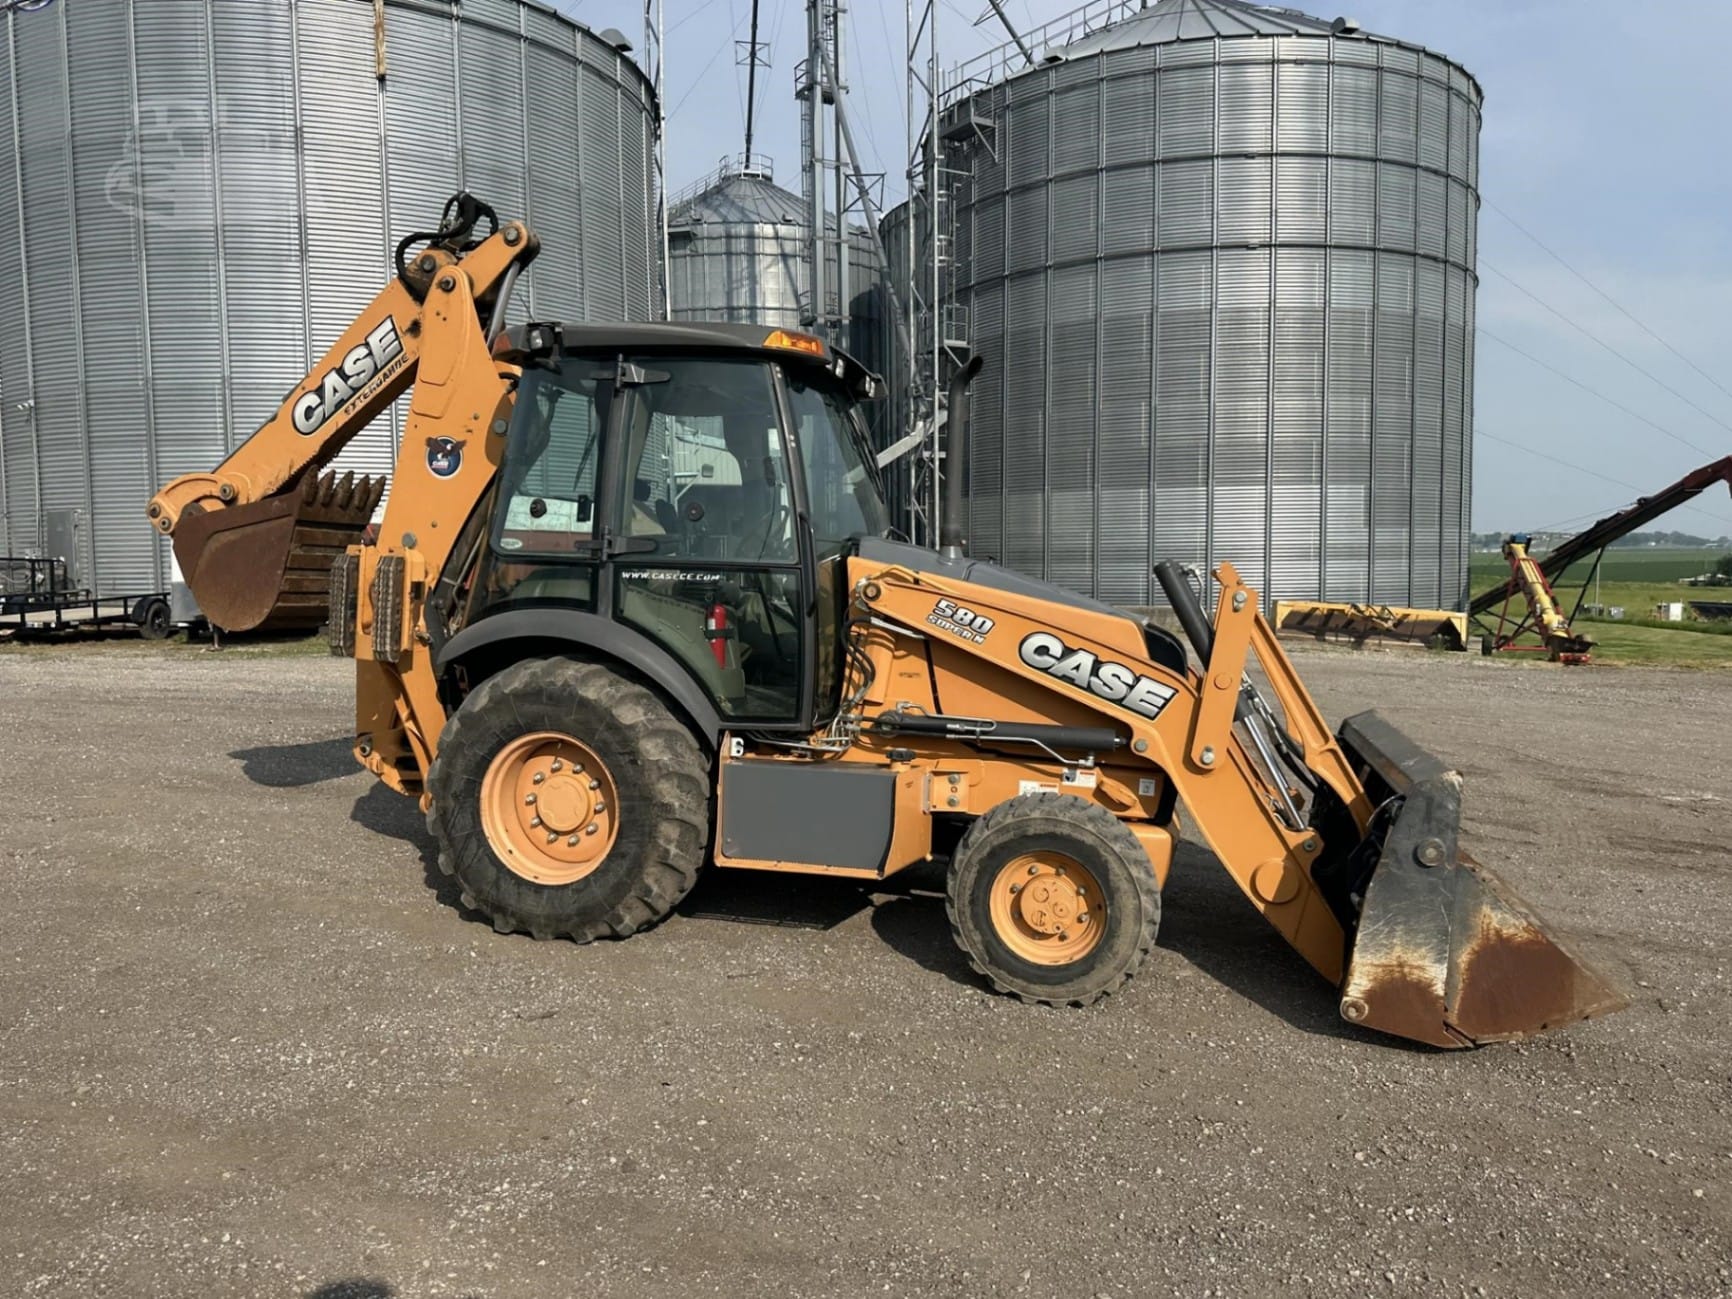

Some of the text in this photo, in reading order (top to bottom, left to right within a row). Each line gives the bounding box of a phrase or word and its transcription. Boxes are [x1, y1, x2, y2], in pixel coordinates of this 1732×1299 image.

[292, 315, 404, 435] CASE
[927, 614, 973, 640] SUPER
[933, 597, 995, 635] 580
[1018, 631, 1179, 721] CASE
